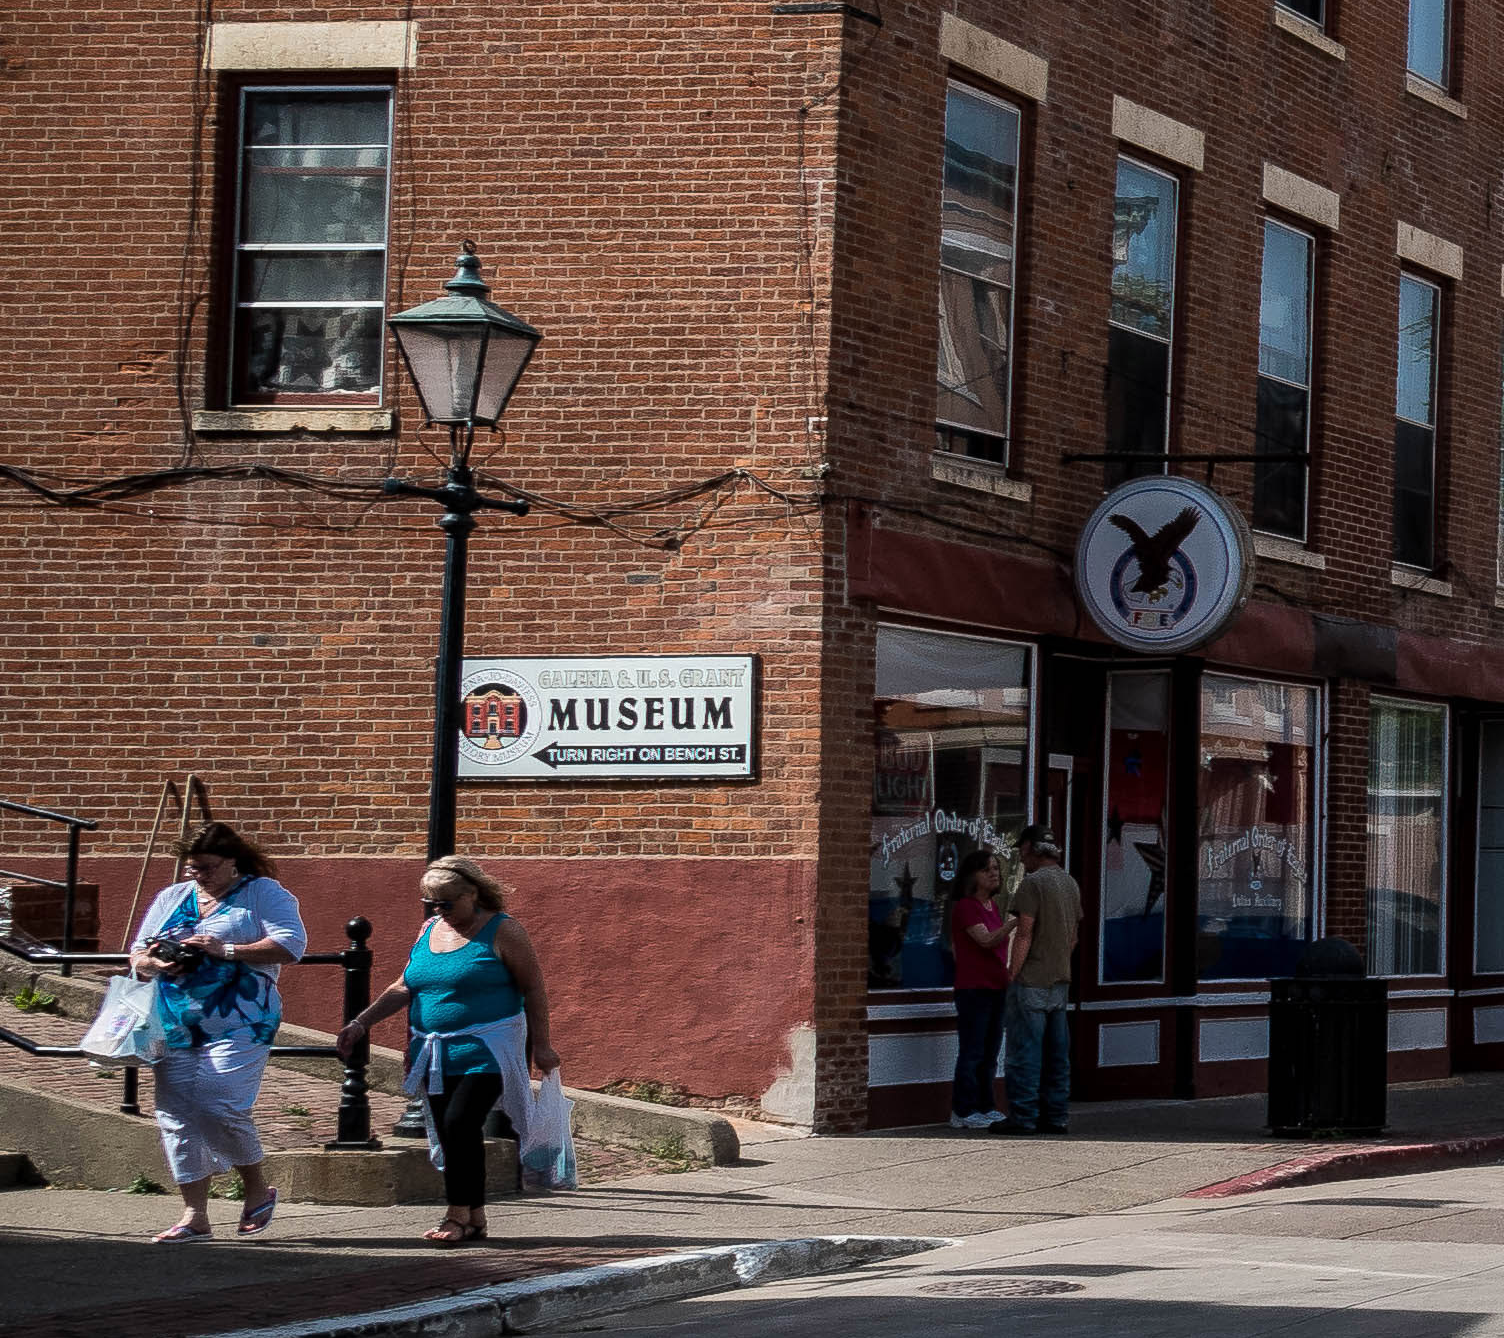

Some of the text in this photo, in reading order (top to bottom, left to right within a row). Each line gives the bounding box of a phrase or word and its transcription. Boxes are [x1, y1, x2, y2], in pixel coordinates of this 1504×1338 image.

[538, 670, 614, 689] GALENA
[617, 670, 633, 689] &
[679, 669, 745, 689] GRANT
[547, 697, 733, 731] MUSEUM
[548, 746, 740, 762] TURN RIGHT ON BENCH ST.
[882, 812, 931, 869] Fraternal
[935, 809, 967, 833] Order
[968, 817, 982, 841] of
